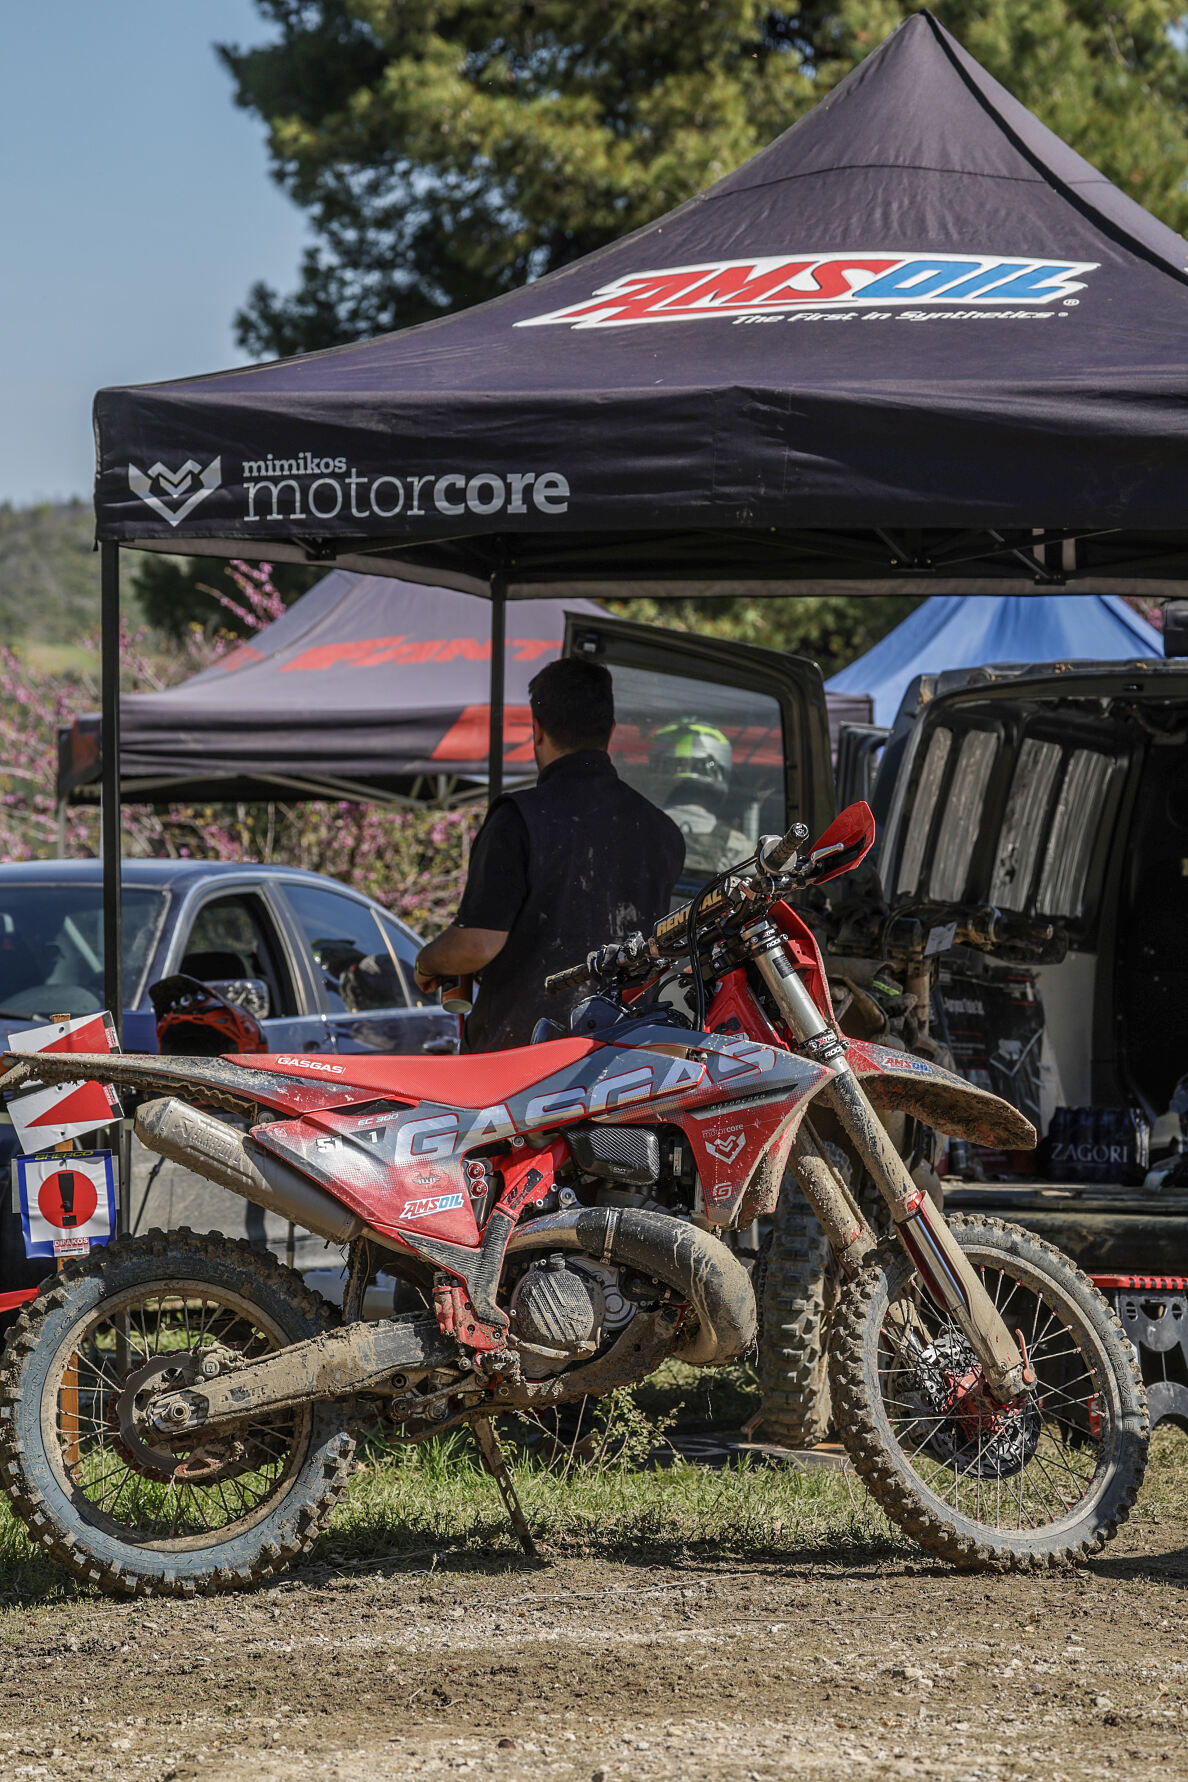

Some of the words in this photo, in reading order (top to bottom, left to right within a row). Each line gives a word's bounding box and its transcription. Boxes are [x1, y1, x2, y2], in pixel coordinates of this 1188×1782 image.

[530, 254, 1088, 326] AMSOIL
[732, 314, 785, 325] The
[788, 311, 859, 322] First
[895, 309, 1055, 321] Synthetics
[242, 452, 347, 477] mimikos
[243, 467, 571, 521] motorcore
[656, 889, 723, 938] RENTAL
[278, 1057, 344, 1074] GASGAS
[883, 1056, 933, 1073] AMSOIL
[358, 1116, 374, 1126] EC
[376, 1113, 398, 1124] 300
[368, 1130, 378, 1143] 1
[702, 1123, 744, 1139] motorcore
[1051, 1143, 1128, 1163] ZAGORI
[401, 1194, 464, 1219] AMSOIL
